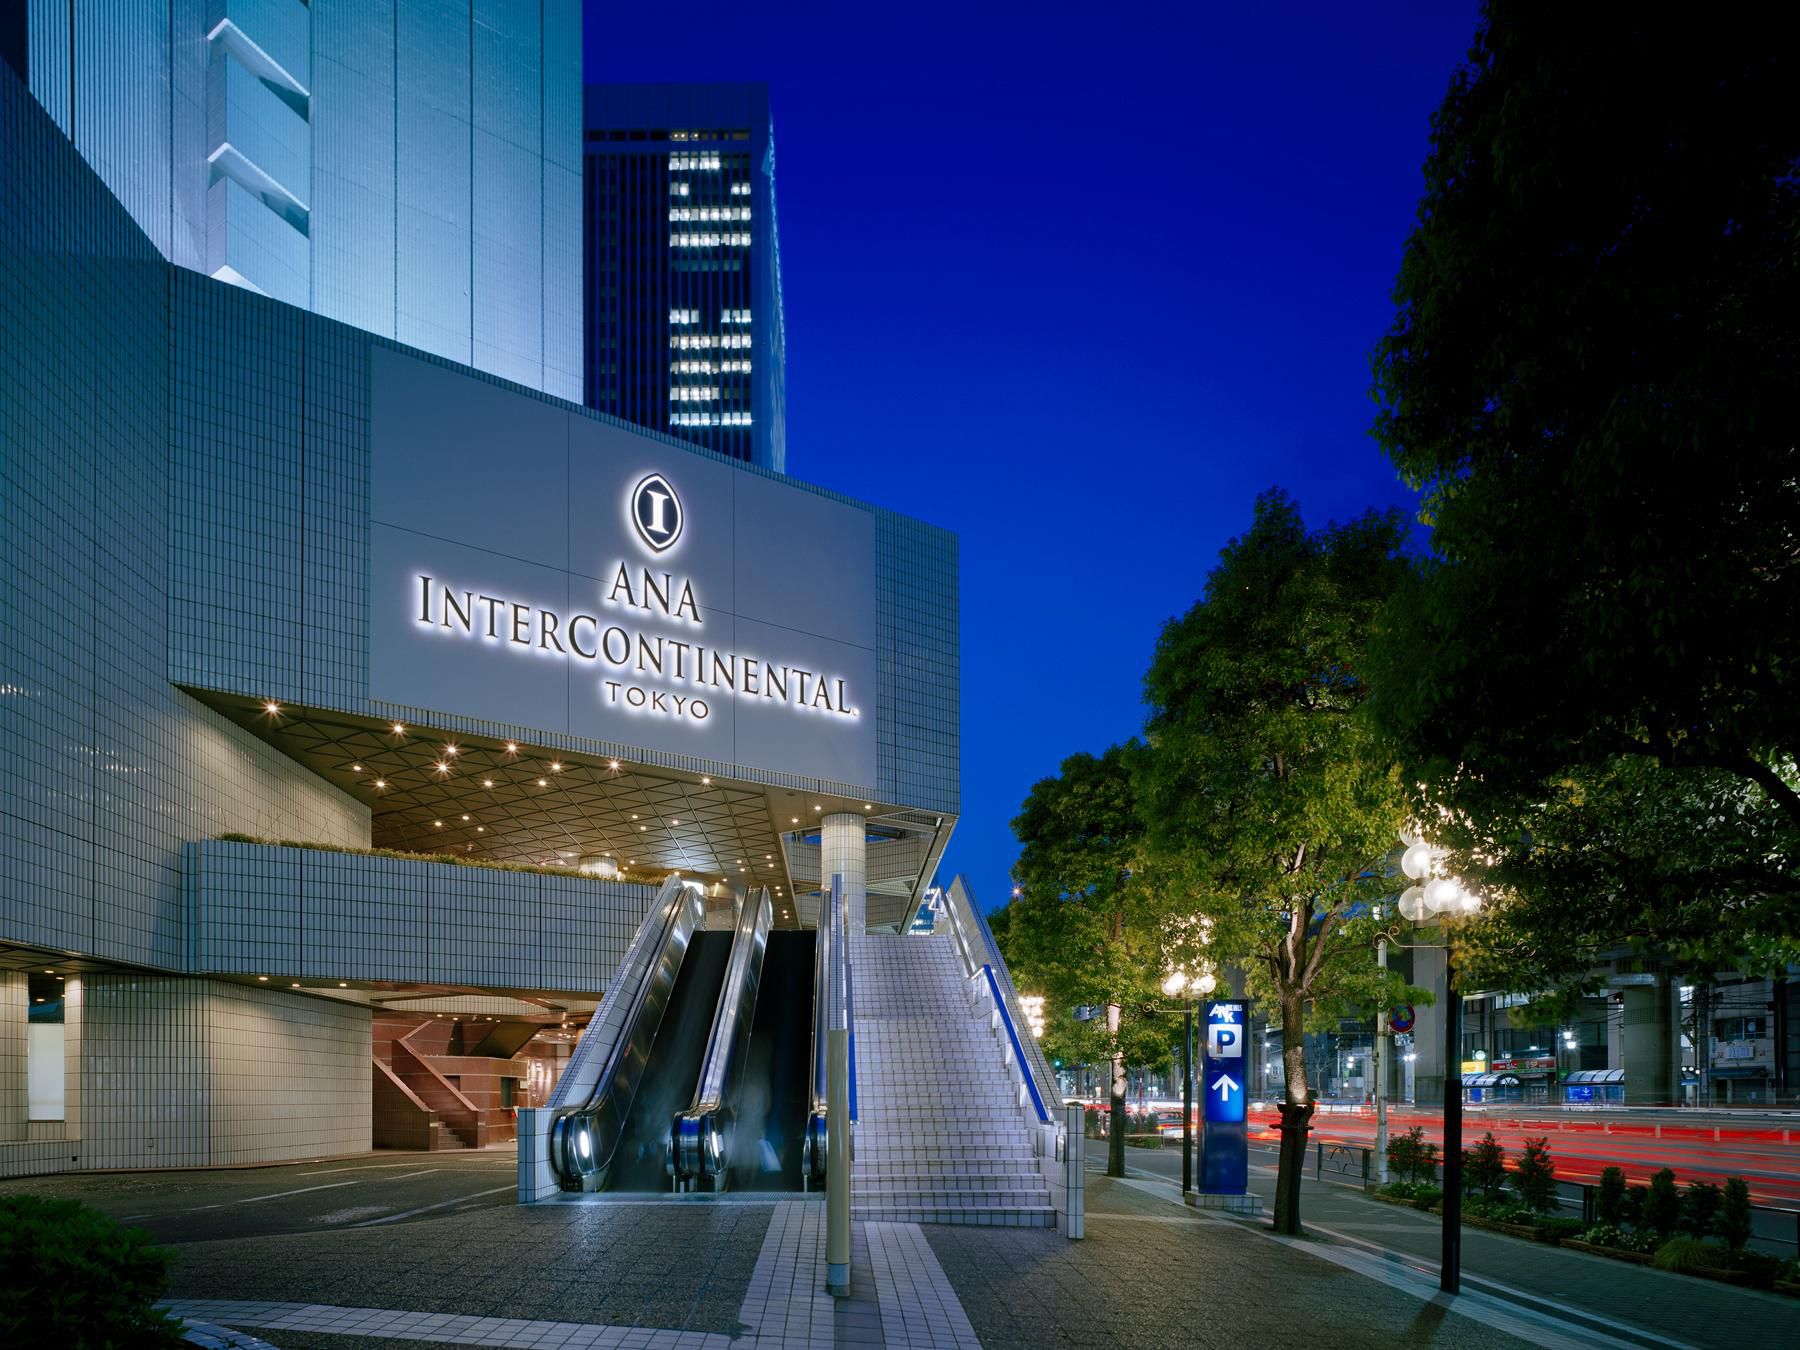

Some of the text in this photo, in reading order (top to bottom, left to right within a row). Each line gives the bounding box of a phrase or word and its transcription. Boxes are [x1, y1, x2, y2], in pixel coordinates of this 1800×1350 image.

[647, 490, 669, 534] I
[607, 561, 702, 622] ANA
[605, 681, 709, 720] TOKYO
[1209, 1003, 1235, 1023] ARK
[1217, 1030, 1236, 1054] P
